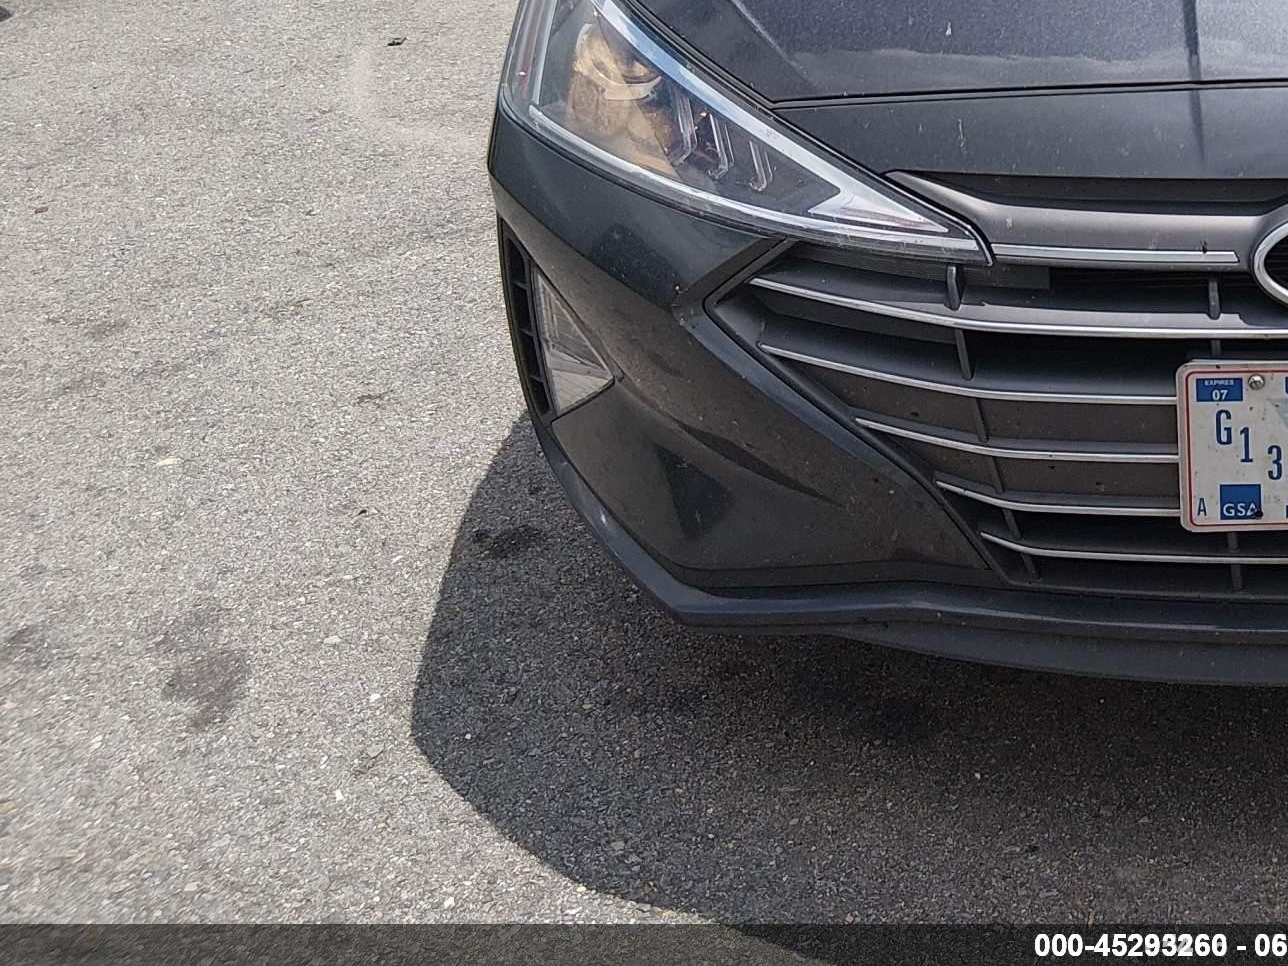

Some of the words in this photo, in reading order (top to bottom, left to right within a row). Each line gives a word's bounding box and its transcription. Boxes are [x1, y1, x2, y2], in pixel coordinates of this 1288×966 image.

[1212, 389, 1228, 401] 07
[1197, 497, 1207, 516] A
[1223, 502, 1260, 516] GSA
